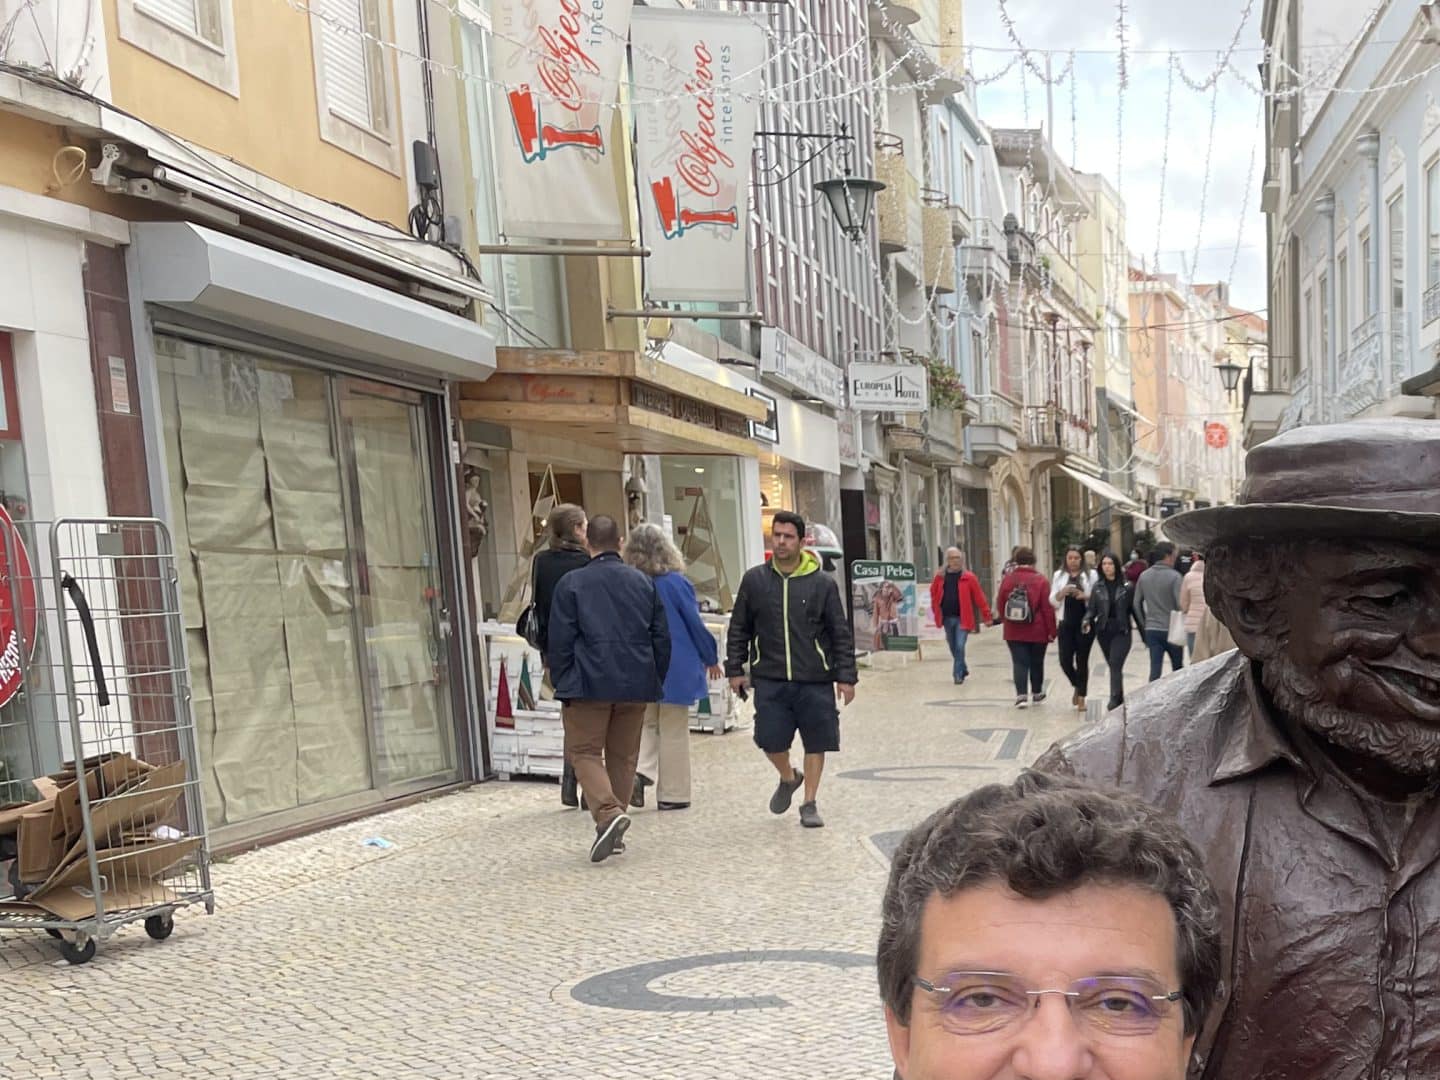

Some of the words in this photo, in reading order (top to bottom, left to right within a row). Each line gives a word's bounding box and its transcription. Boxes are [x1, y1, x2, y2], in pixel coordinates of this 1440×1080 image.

[720, 44, 733, 144] interiores
[853, 564, 879, 576] Casa
[886, 564, 914, 577] Peles
